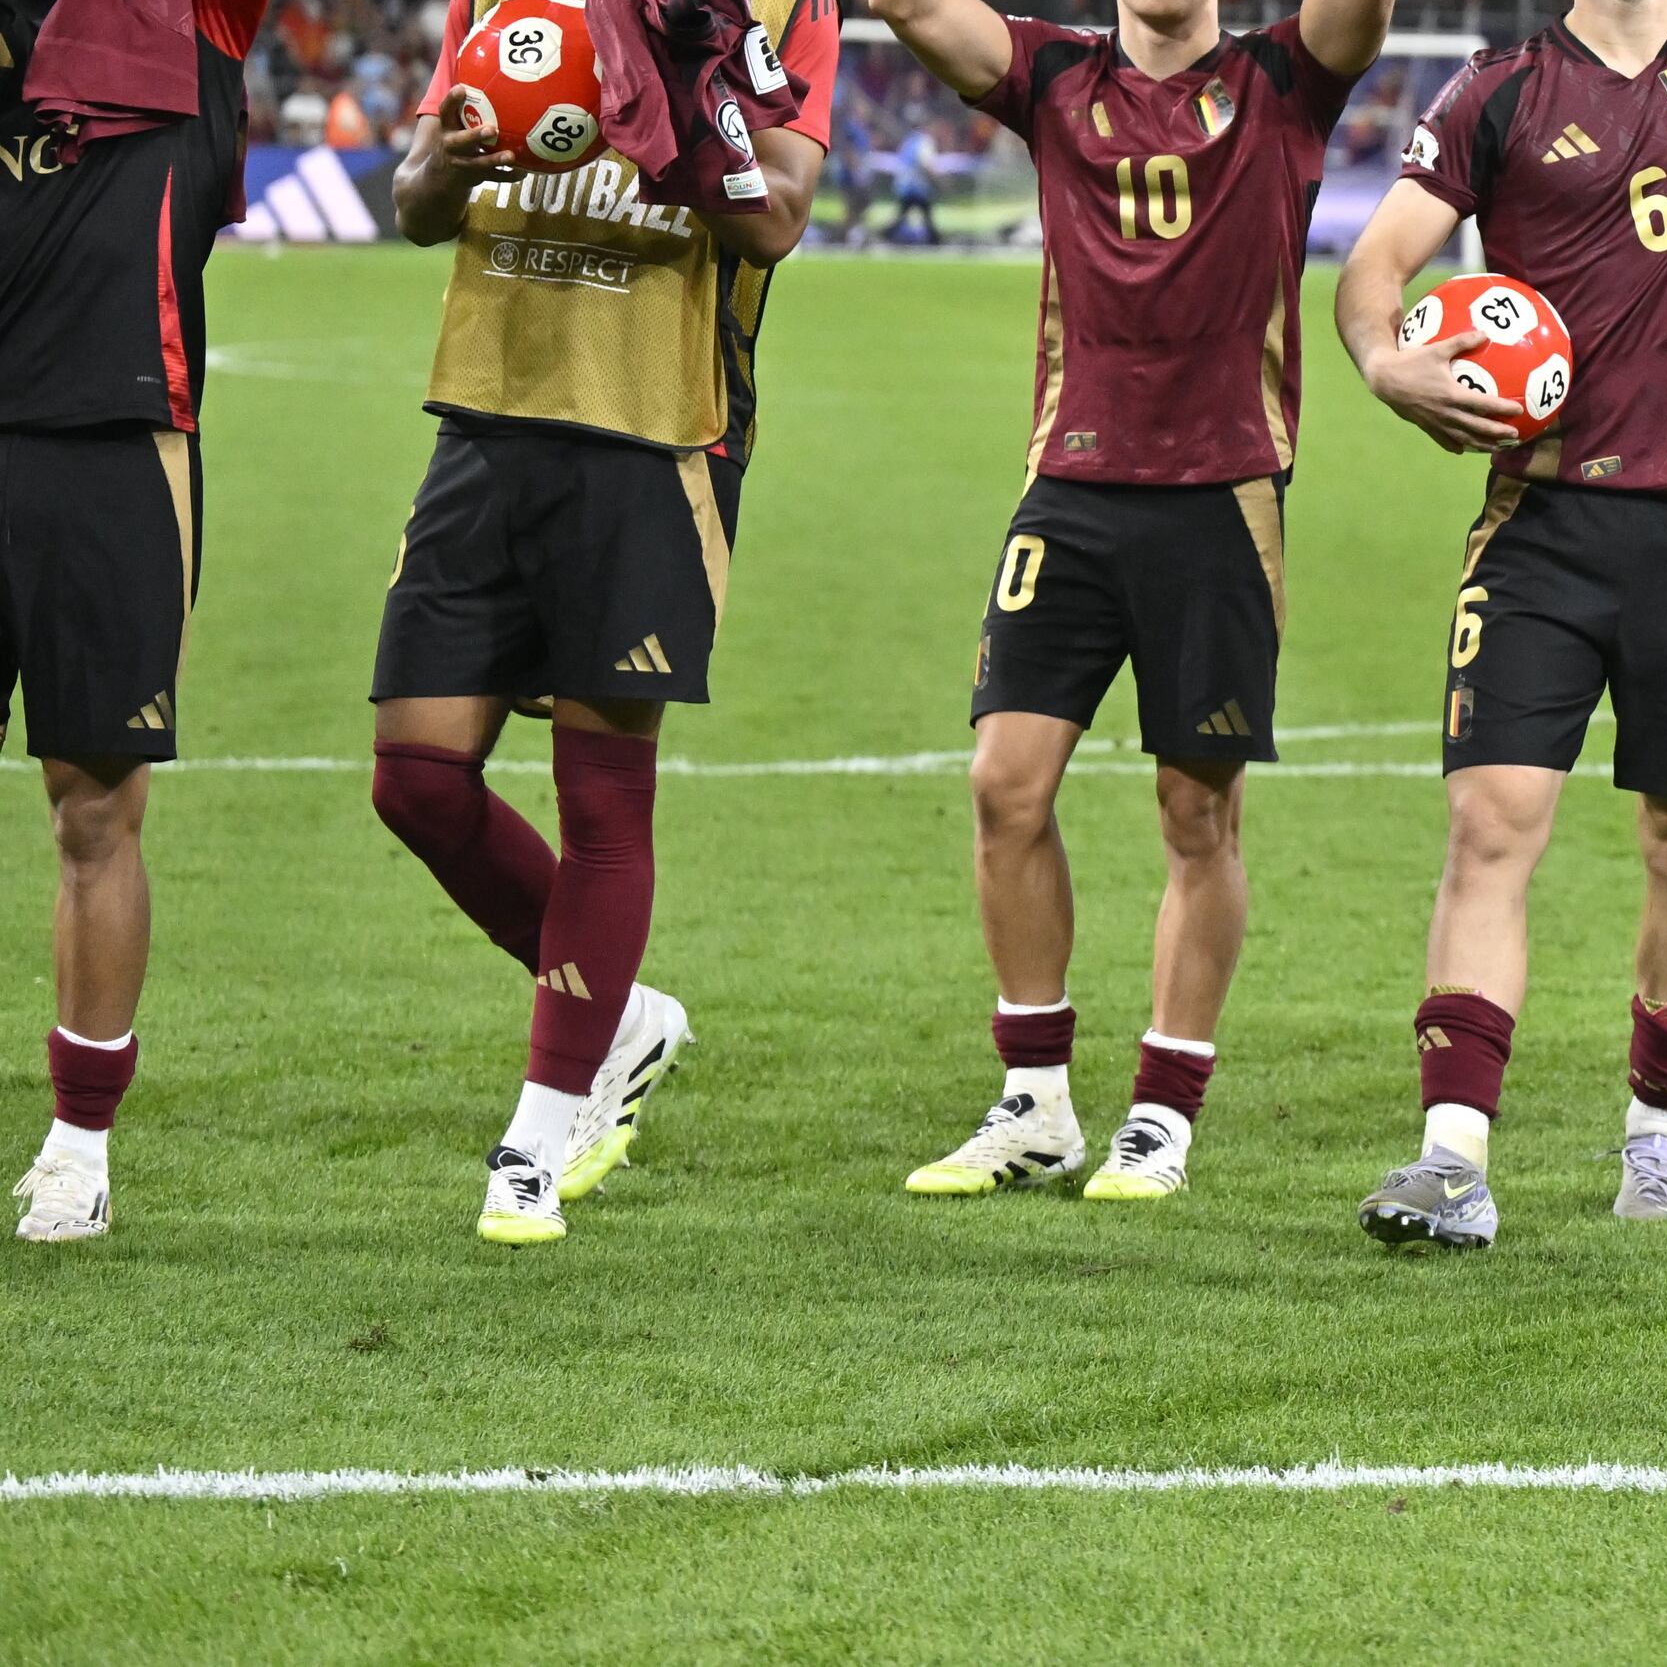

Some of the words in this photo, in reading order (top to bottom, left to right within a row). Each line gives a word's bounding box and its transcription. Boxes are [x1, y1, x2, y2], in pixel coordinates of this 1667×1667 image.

[541, 116, 584, 152] 39
[0, 134, 63, 182] NG
[1116, 154, 1191, 240] 10
[524, 247, 635, 284] RESPECT
[1481, 296, 1520, 330] 43
[1539, 370, 1565, 409] 43
[1452, 586, 1489, 669] 6
